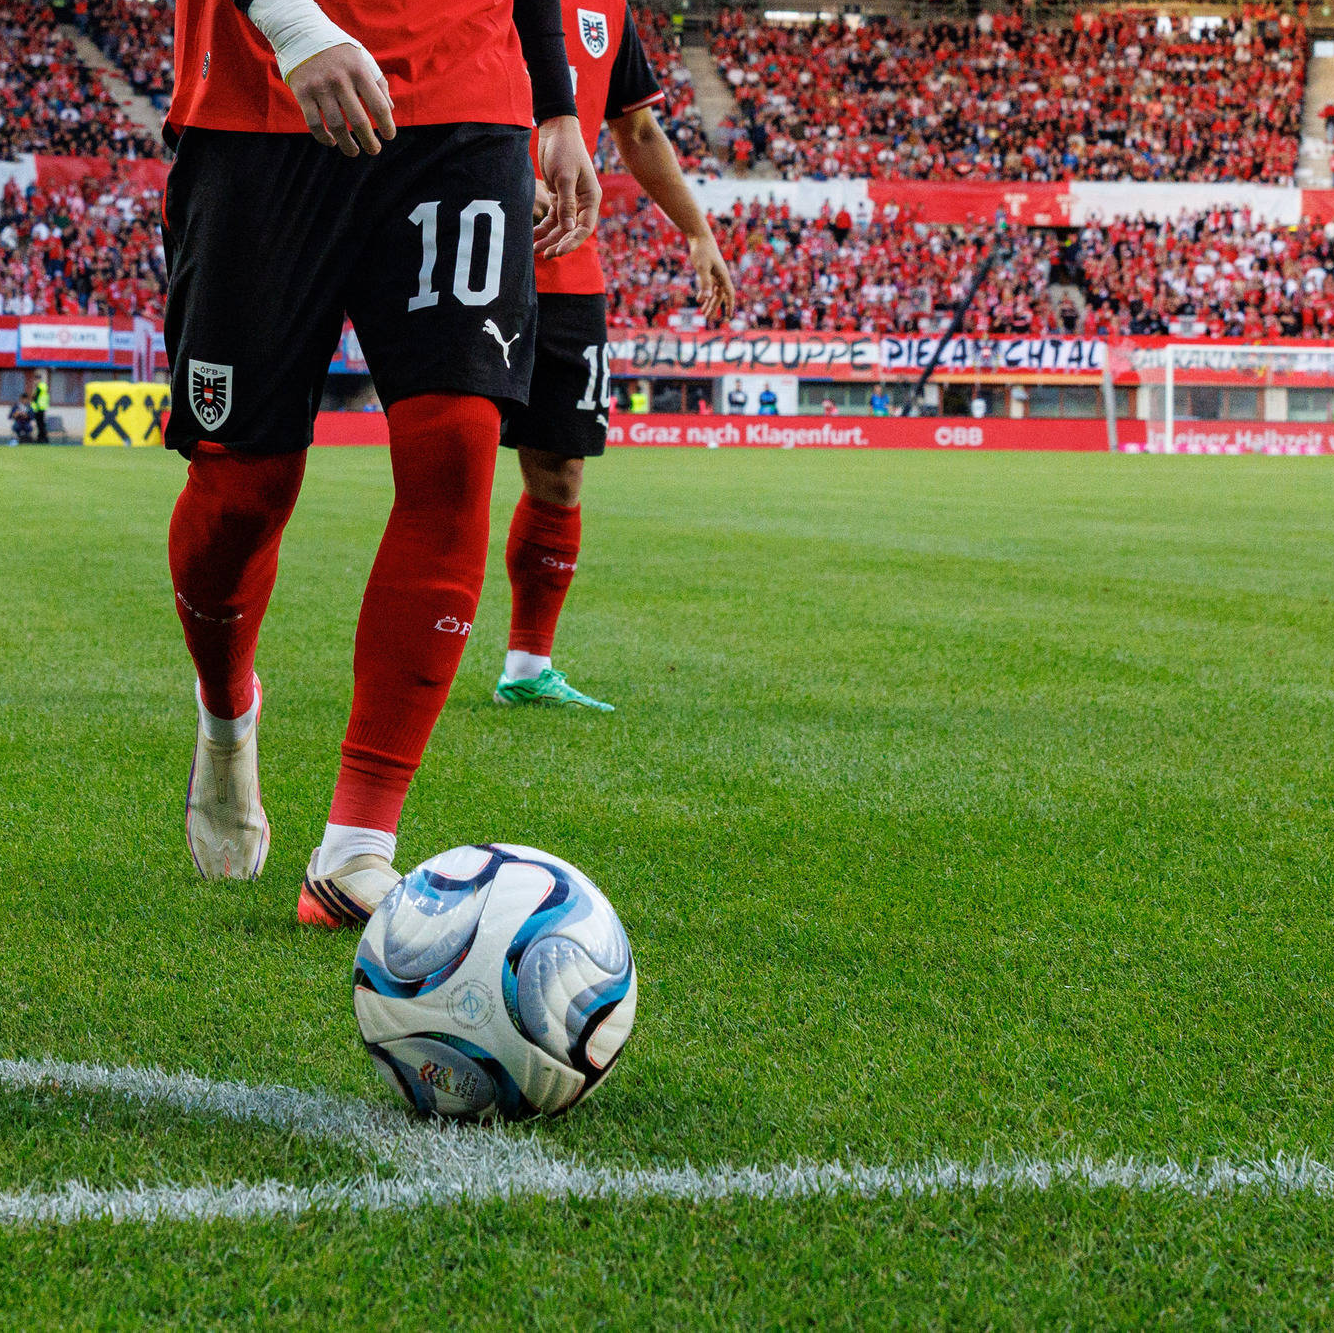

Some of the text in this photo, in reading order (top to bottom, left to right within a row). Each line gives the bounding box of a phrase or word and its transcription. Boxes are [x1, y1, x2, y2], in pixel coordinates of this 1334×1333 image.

[407, 199, 506, 312] 10
[631, 334, 873, 370] BLUTGRUPPE
[629, 422, 681, 445] Graz
[686, 422, 741, 445] nach
[745, 422, 868, 450] Klagenfurt.
